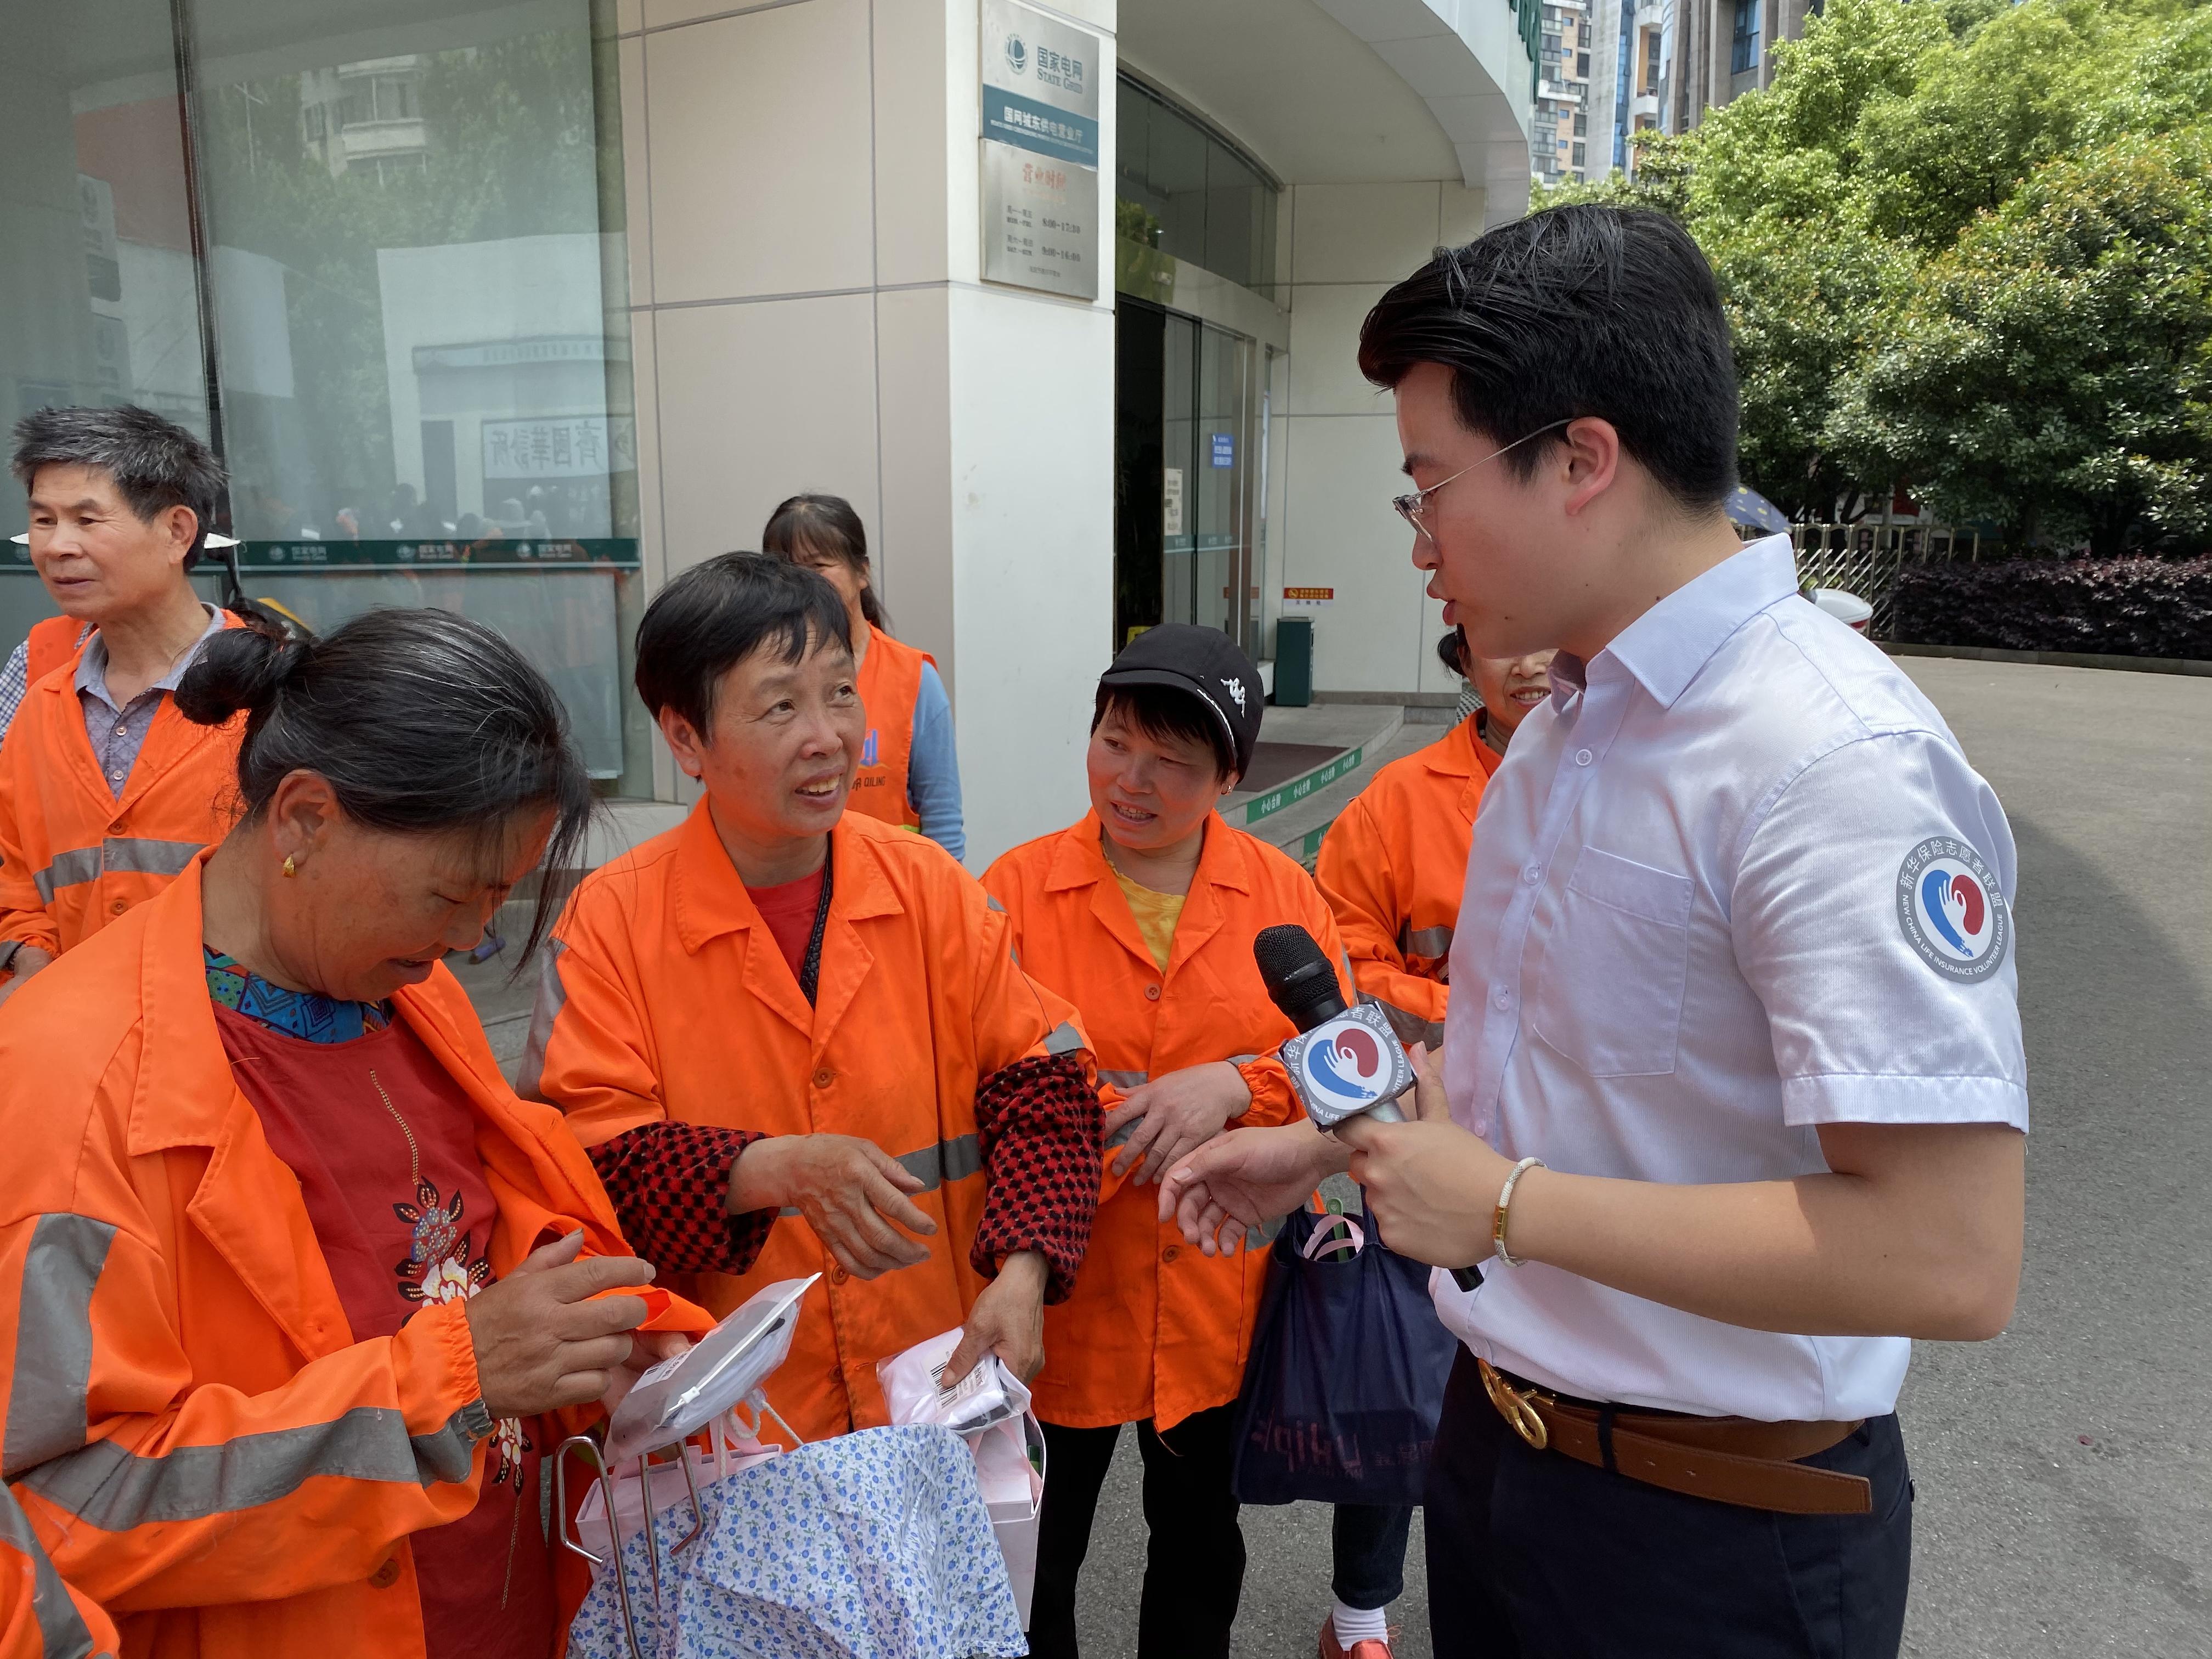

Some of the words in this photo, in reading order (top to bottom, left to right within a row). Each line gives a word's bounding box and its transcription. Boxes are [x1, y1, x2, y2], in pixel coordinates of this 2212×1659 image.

[1037, 46, 1082, 81] 国家电网
[1900, 839, 2002, 909] 新华保险志愿者联盟
[1902, 894, 1911, 915] NEW
[1906, 917, 1921, 944] CHINA
[1921, 943, 1934, 959] LIFE
[1973, 945, 2000, 974] VOLUNTEER
[1934, 956, 1973, 975] INSURANCE
[1392, 1039, 1404, 1068] LEAGUE
[1325, 1111, 1340, 1121] LIFE
